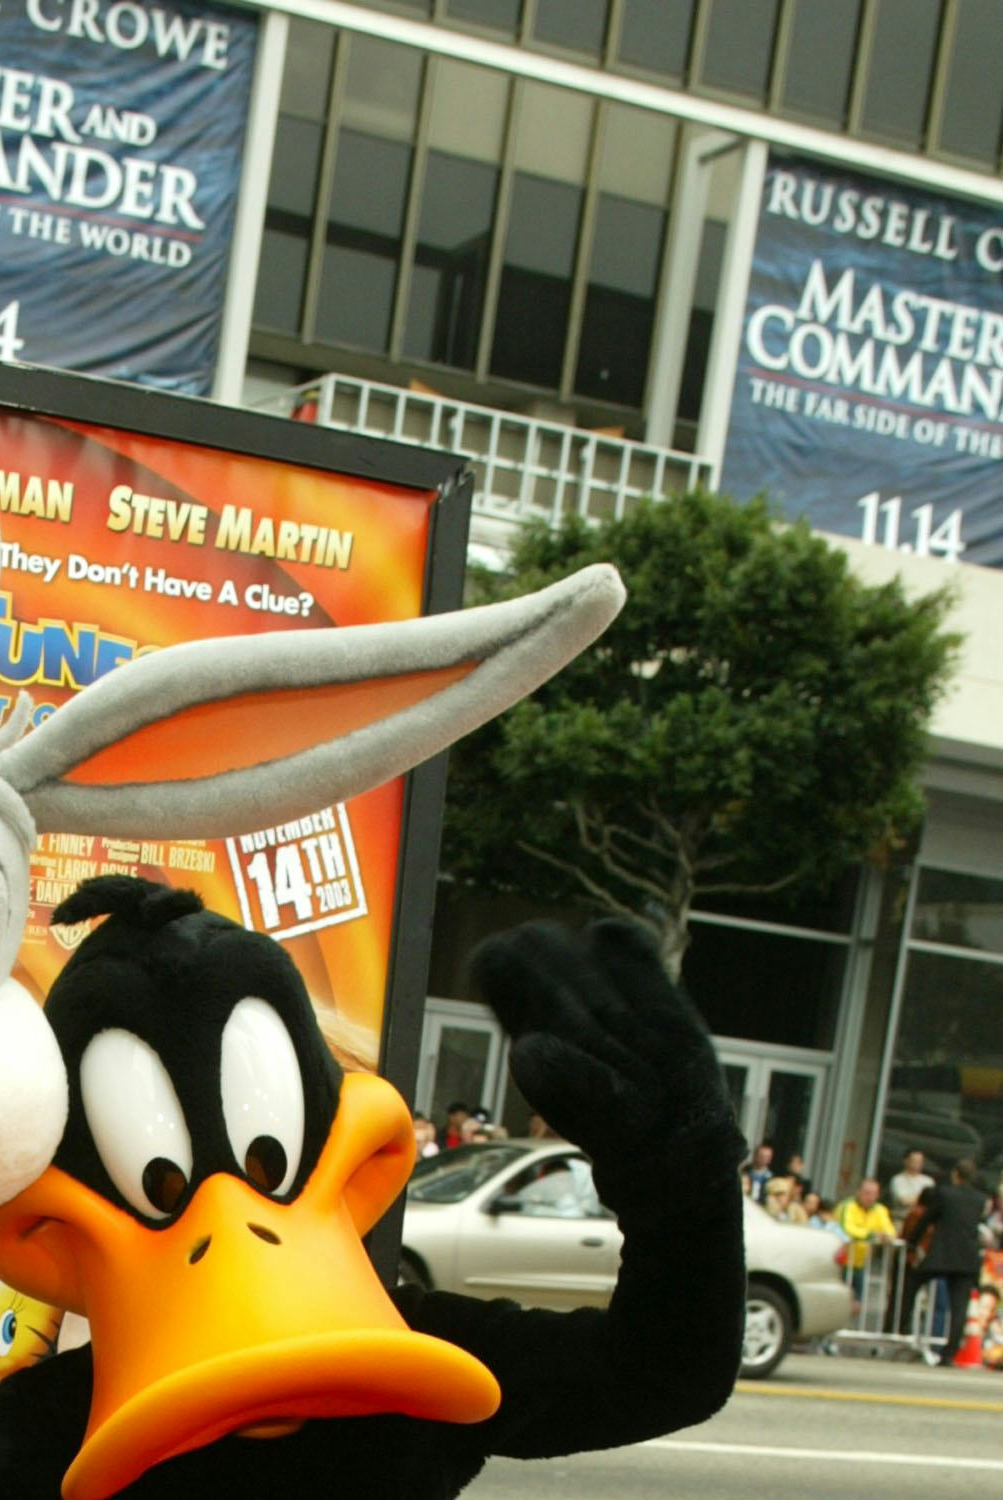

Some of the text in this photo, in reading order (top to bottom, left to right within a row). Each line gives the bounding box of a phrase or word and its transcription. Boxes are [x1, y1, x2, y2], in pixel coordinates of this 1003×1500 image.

[26, 0, 229, 70] CROWE
[81, 104, 156, 147] AND
[8, 206, 71, 244] THE
[80, 222, 192, 268] WORLD
[768, 168, 958, 261] RUSSELL
[746, 305, 1003, 424] COMMAN
[749, 378, 798, 414] THE
[803, 394, 850, 423] FAR
[853, 405, 909, 440] SIDE
[913, 418, 949, 447] OF
[107, 485, 353, 570] STEVE MARTIN
[858, 491, 966, 563] 11.14
[0, 542, 314, 617] They Don't Have A Clue?
[140, 842, 165, 866] BILL
[315, 878, 352, 913] 2003
